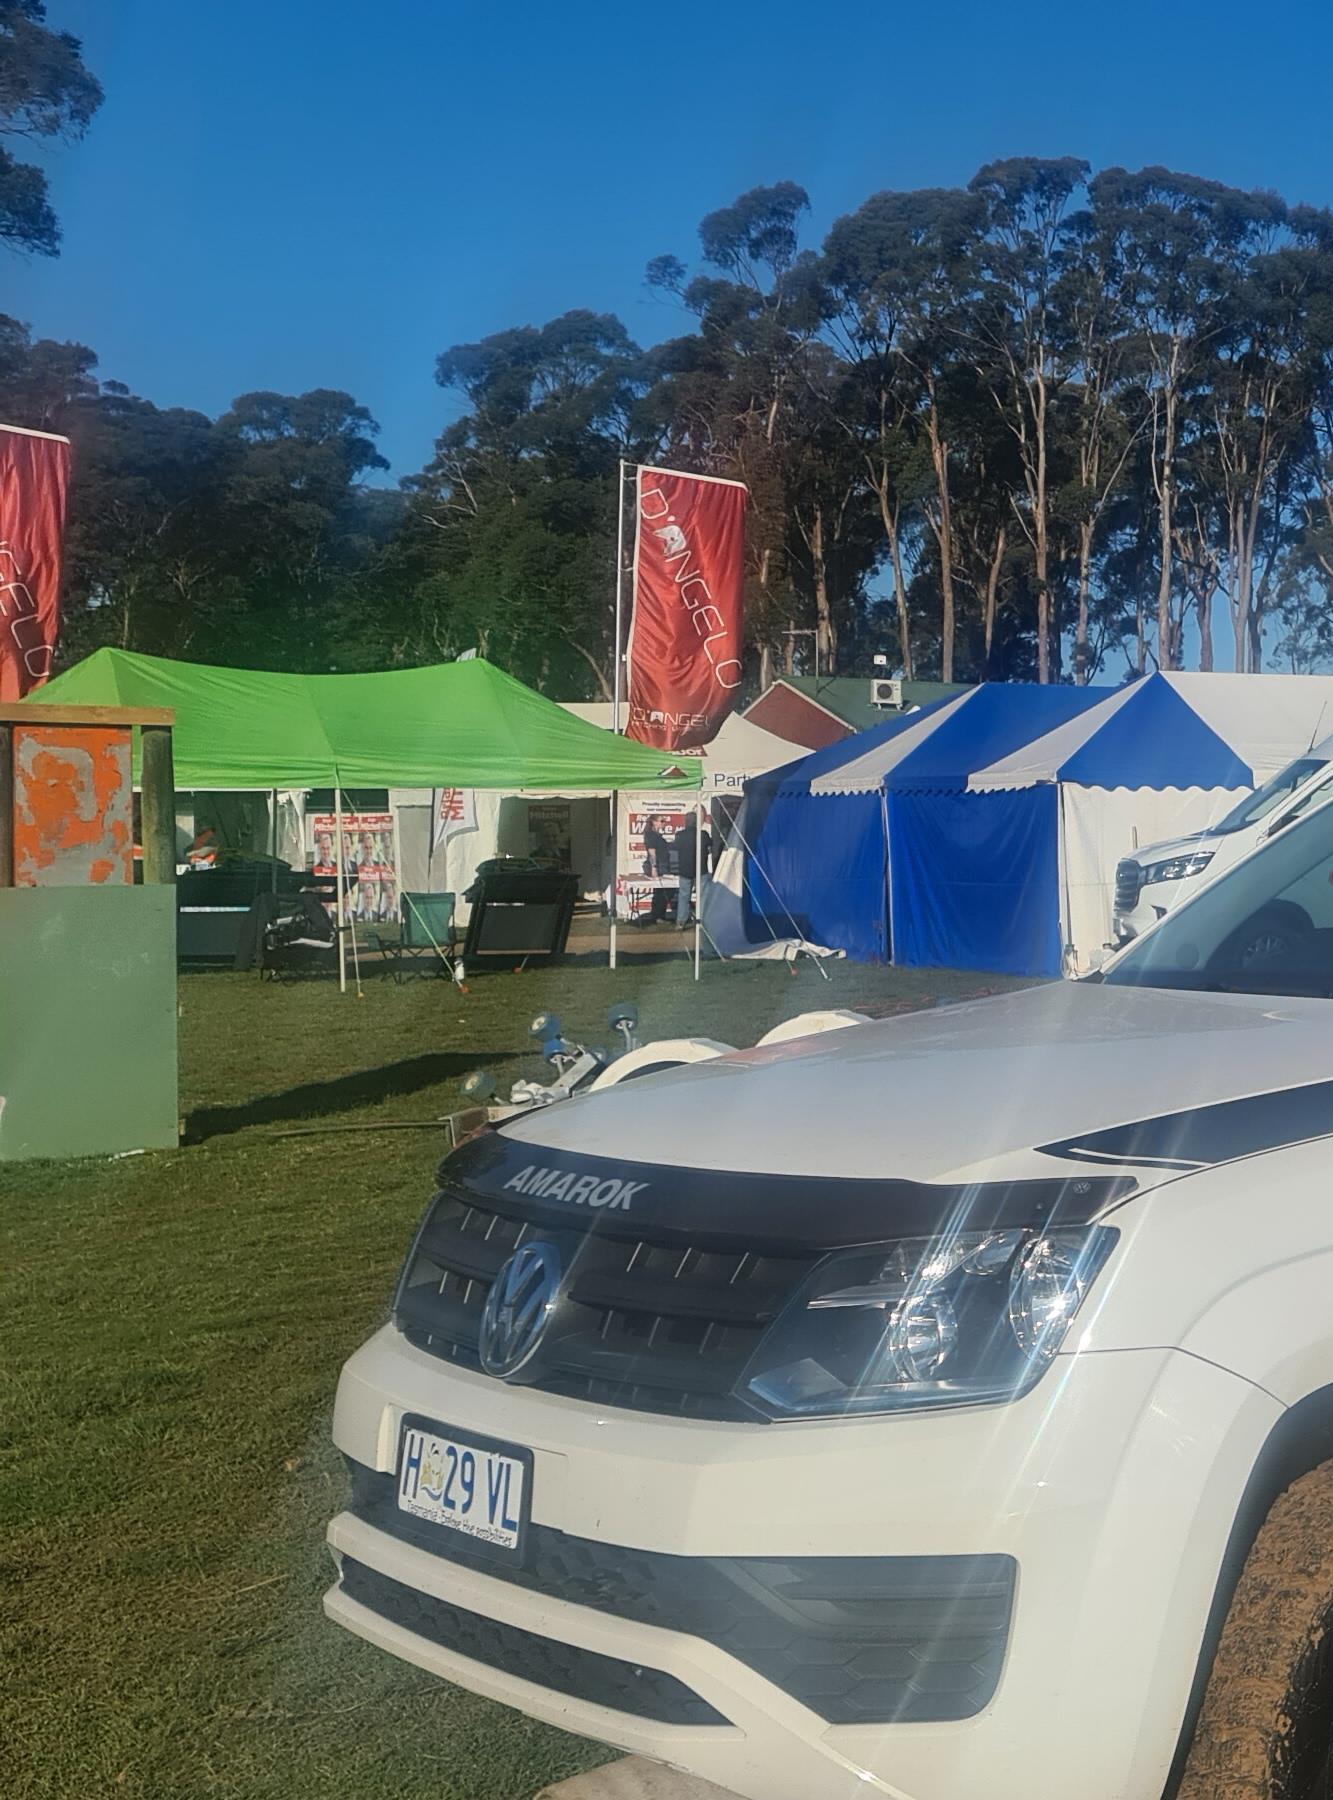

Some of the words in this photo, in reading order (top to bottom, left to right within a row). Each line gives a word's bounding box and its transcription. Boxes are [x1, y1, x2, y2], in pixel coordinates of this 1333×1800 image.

[714, 773, 751, 788] Part
[503, 1165, 652, 1210] AMAROK
[487, 1458, 518, 1533] VL
